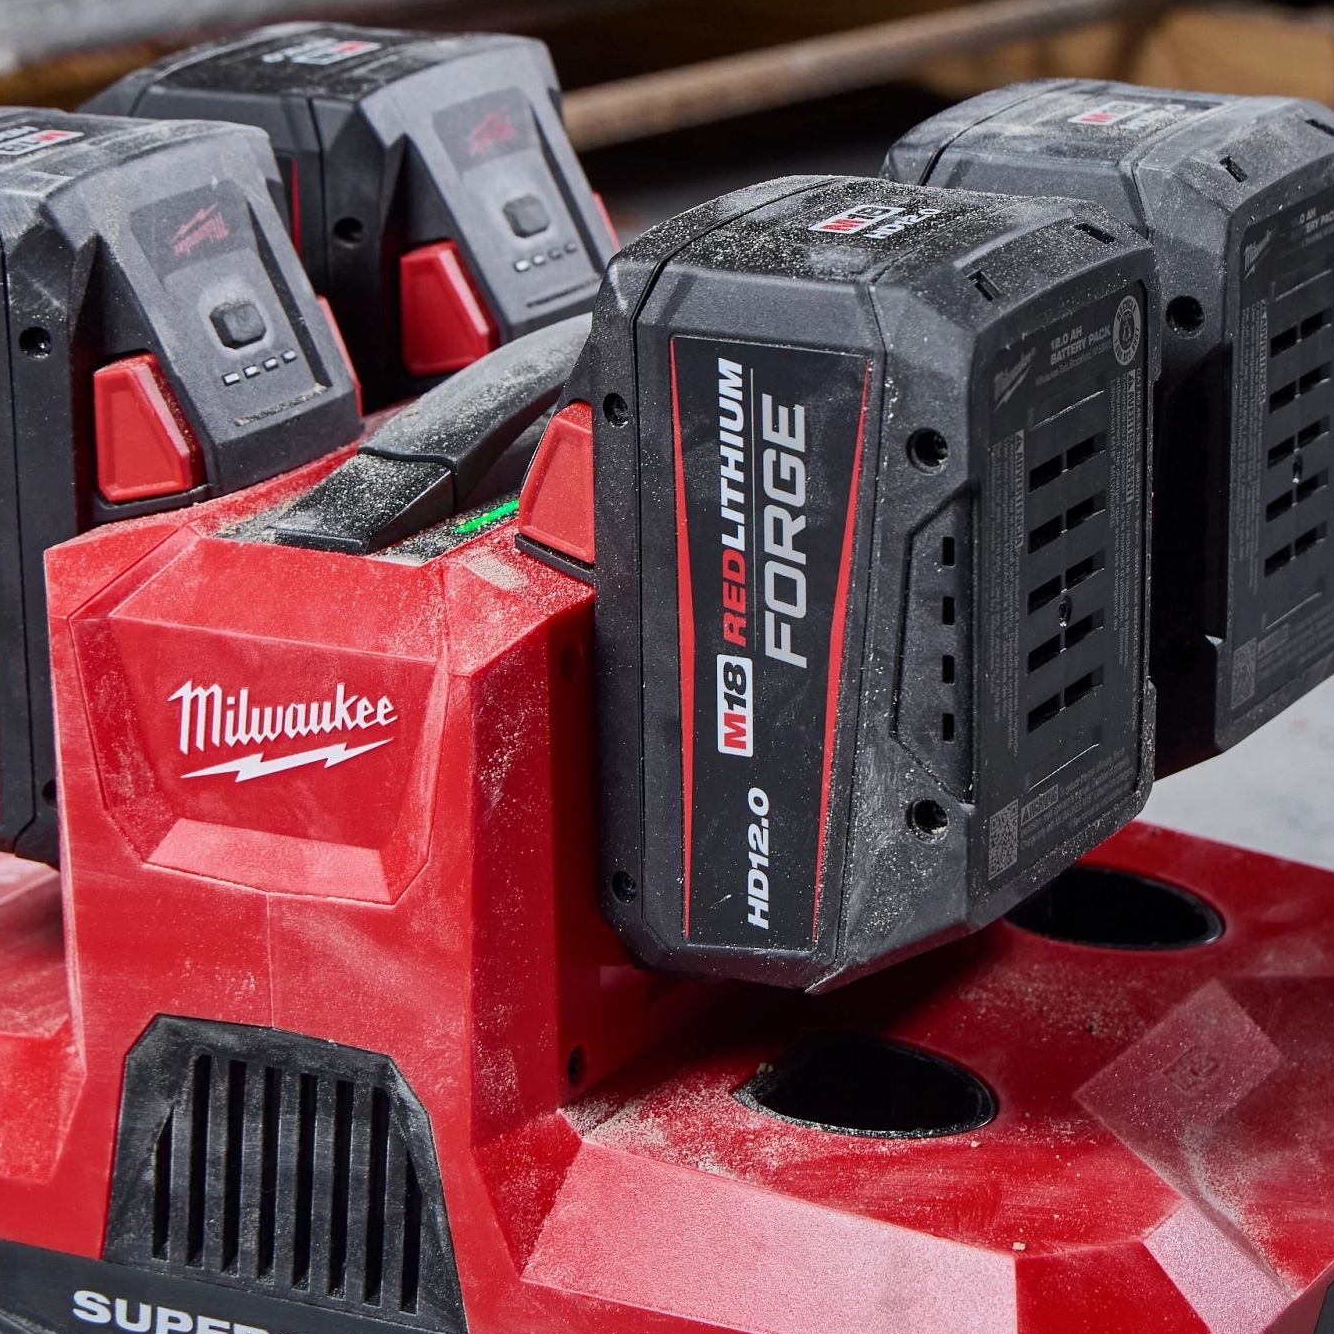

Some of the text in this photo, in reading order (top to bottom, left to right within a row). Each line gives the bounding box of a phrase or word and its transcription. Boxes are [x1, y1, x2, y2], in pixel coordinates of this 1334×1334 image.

[1050, 325, 1083, 352] 12.0 AH
[1050, 325, 1112, 365] BATTERY PACK
[718, 357, 747, 750] M18 REDLITHIUM
[762, 393, 807, 668] FORGE
[168, 680, 398, 755] Milwaukee
[748, 787, 769, 929] HD12.0
